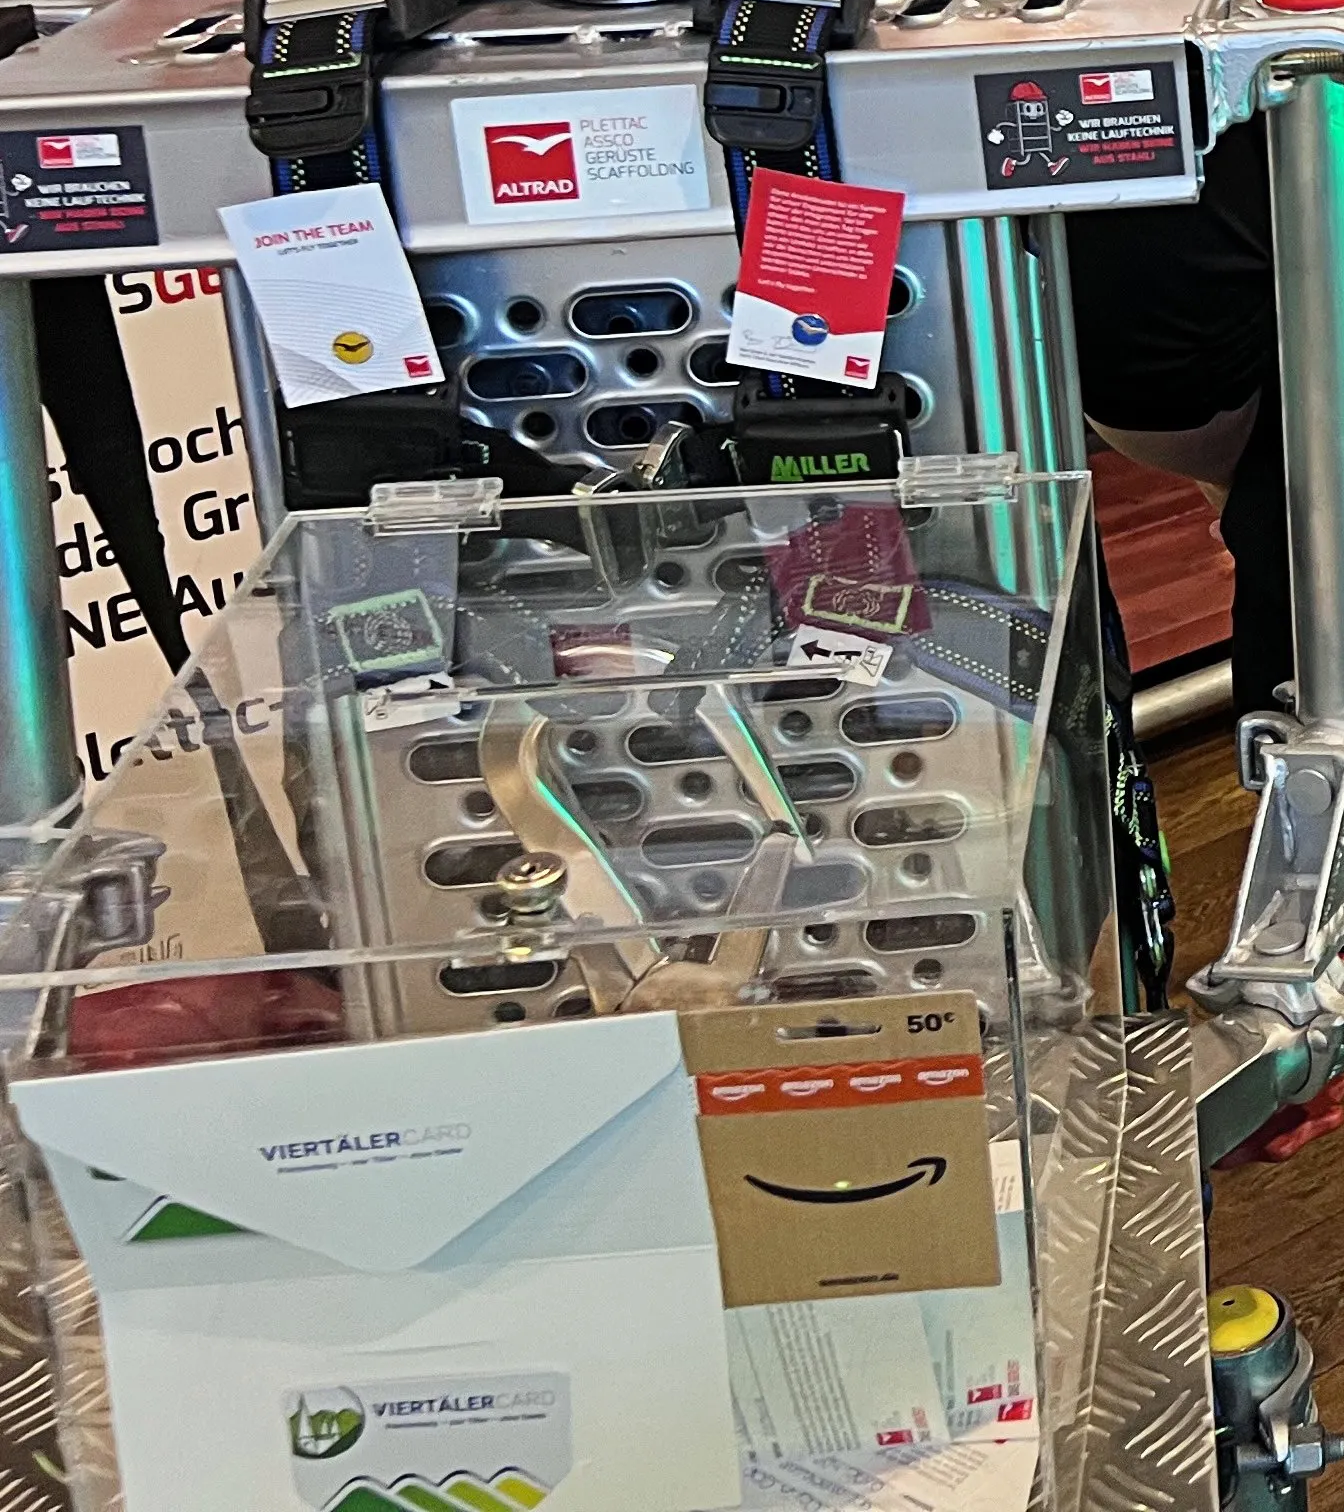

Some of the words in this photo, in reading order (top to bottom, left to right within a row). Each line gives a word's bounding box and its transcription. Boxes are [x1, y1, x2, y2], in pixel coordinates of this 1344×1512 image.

[579, 116, 648, 132] PLETTAC
[1103, 114, 1161, 127] BRAUCHEN
[584, 134, 634, 148] ASSCO
[585, 145, 656, 164] GERÜSTE
[586, 162, 695, 181] SCAFFOLDING
[497, 179, 574, 198] ALTRAD
[255, 231, 289, 249] JOIN
[292, 226, 325, 241] THE
[326, 219, 375, 236] TEAM
[771, 453, 870, 481] MILLER
